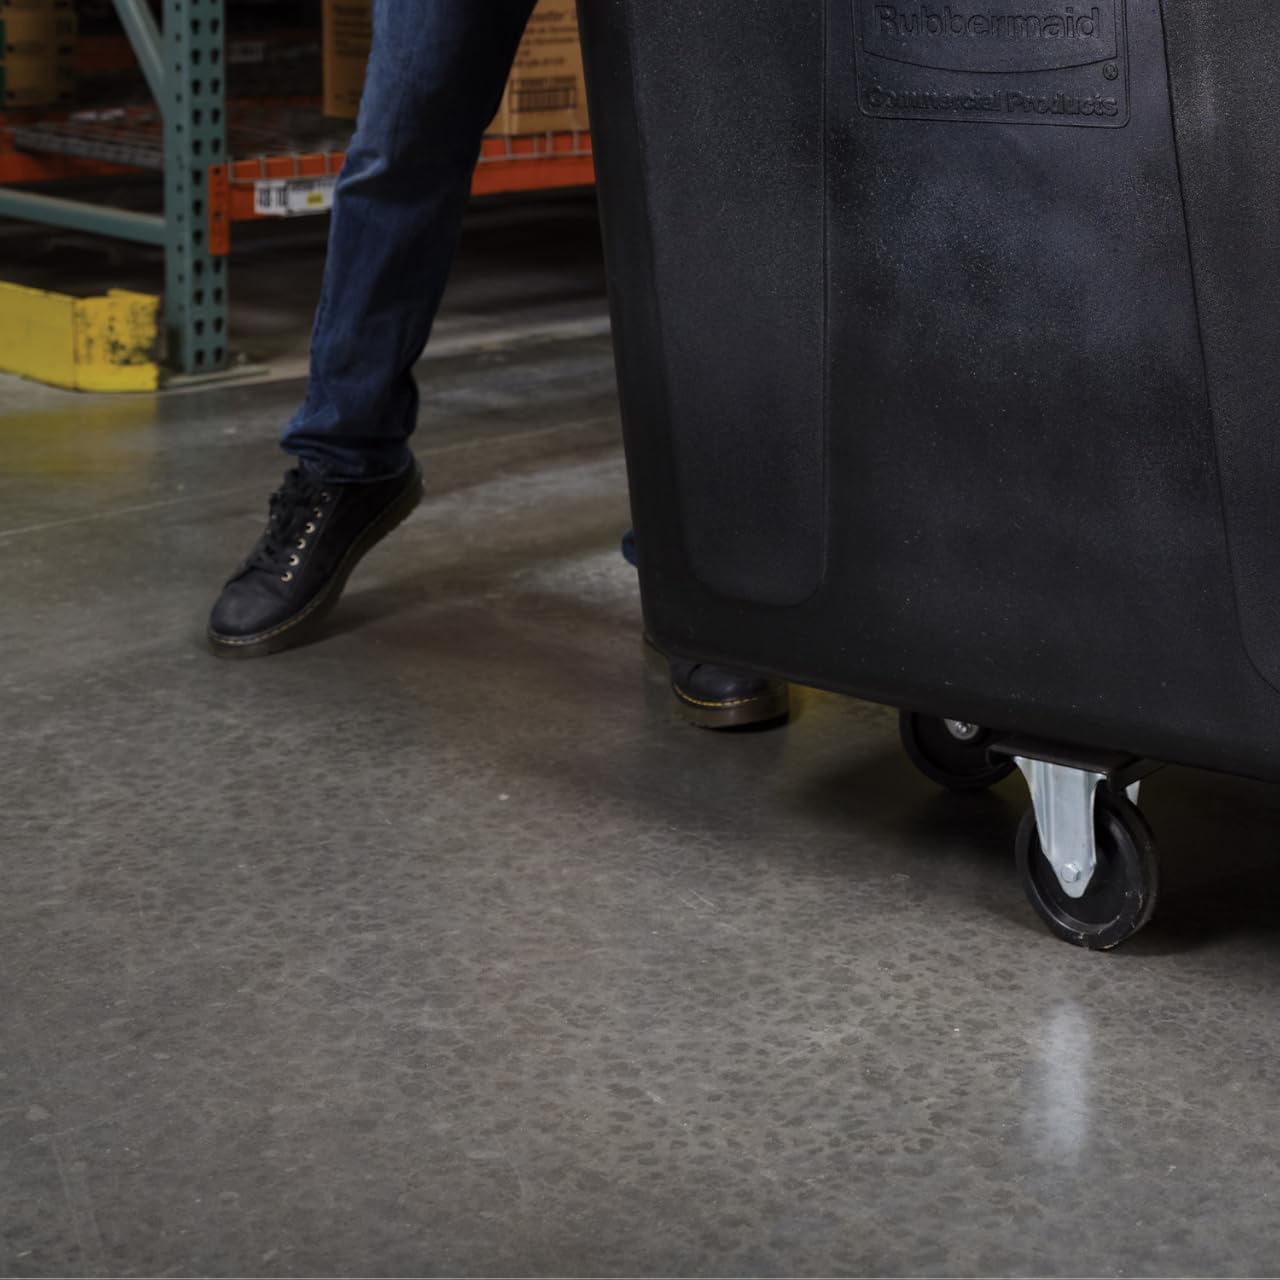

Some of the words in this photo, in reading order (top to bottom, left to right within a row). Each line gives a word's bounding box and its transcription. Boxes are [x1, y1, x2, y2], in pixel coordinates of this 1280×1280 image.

[874, 4, 1100, 39] Rubbermaid
[868, 87, 1001, 113] Commercial
[1005, 89, 1119, 118] Products
